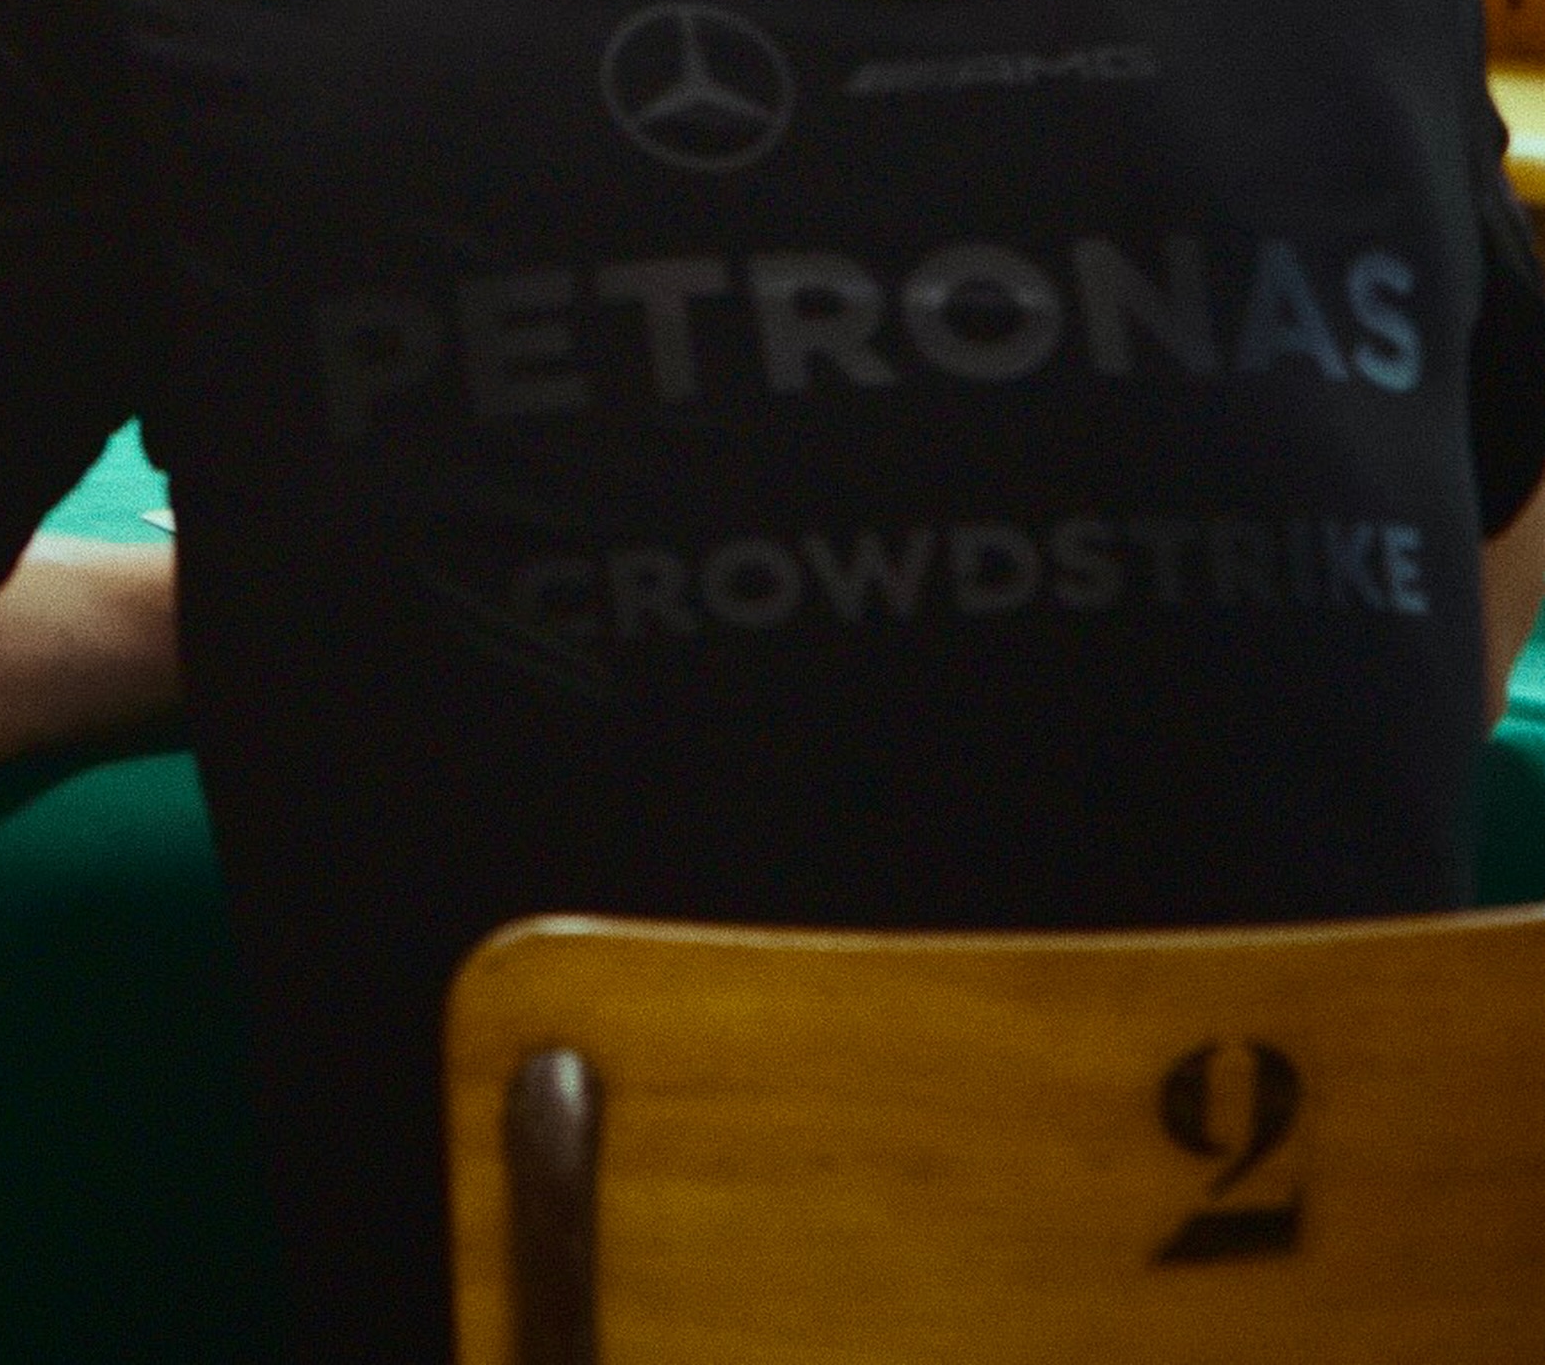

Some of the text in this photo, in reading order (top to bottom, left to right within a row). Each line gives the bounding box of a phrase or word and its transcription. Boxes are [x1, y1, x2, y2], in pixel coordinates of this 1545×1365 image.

[311, 233, 1422, 440] PETRONAS
[510, 517, 1432, 641] CROWDSTRIKE
[1151, 1037, 1307, 1268] 2
